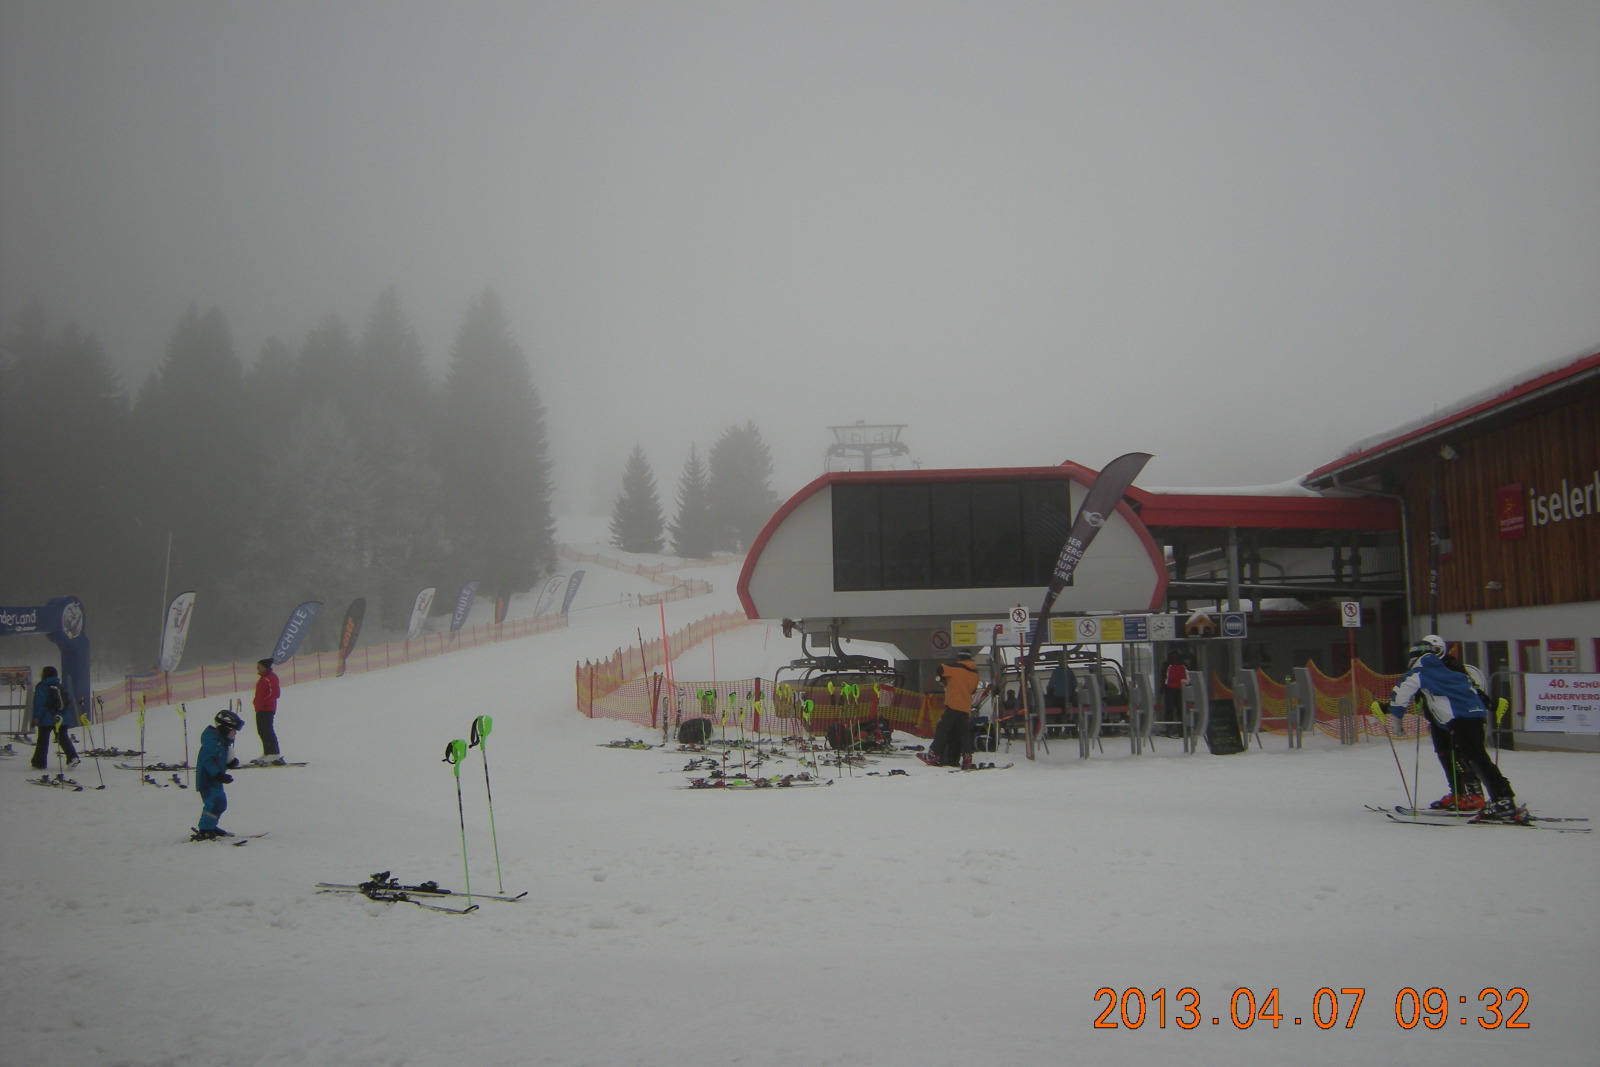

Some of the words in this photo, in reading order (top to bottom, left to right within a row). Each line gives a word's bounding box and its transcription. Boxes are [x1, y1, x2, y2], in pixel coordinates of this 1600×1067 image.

[1064, 544, 1083, 558] ERG
[1060, 552, 1080, 565] UFT
[454, 588, 470, 625] SCHULE
[277, 609, 308, 658] SCHULE
[1549, 679, 1569, 688] 40.
[1535, 704, 1565, 712] Bayern
